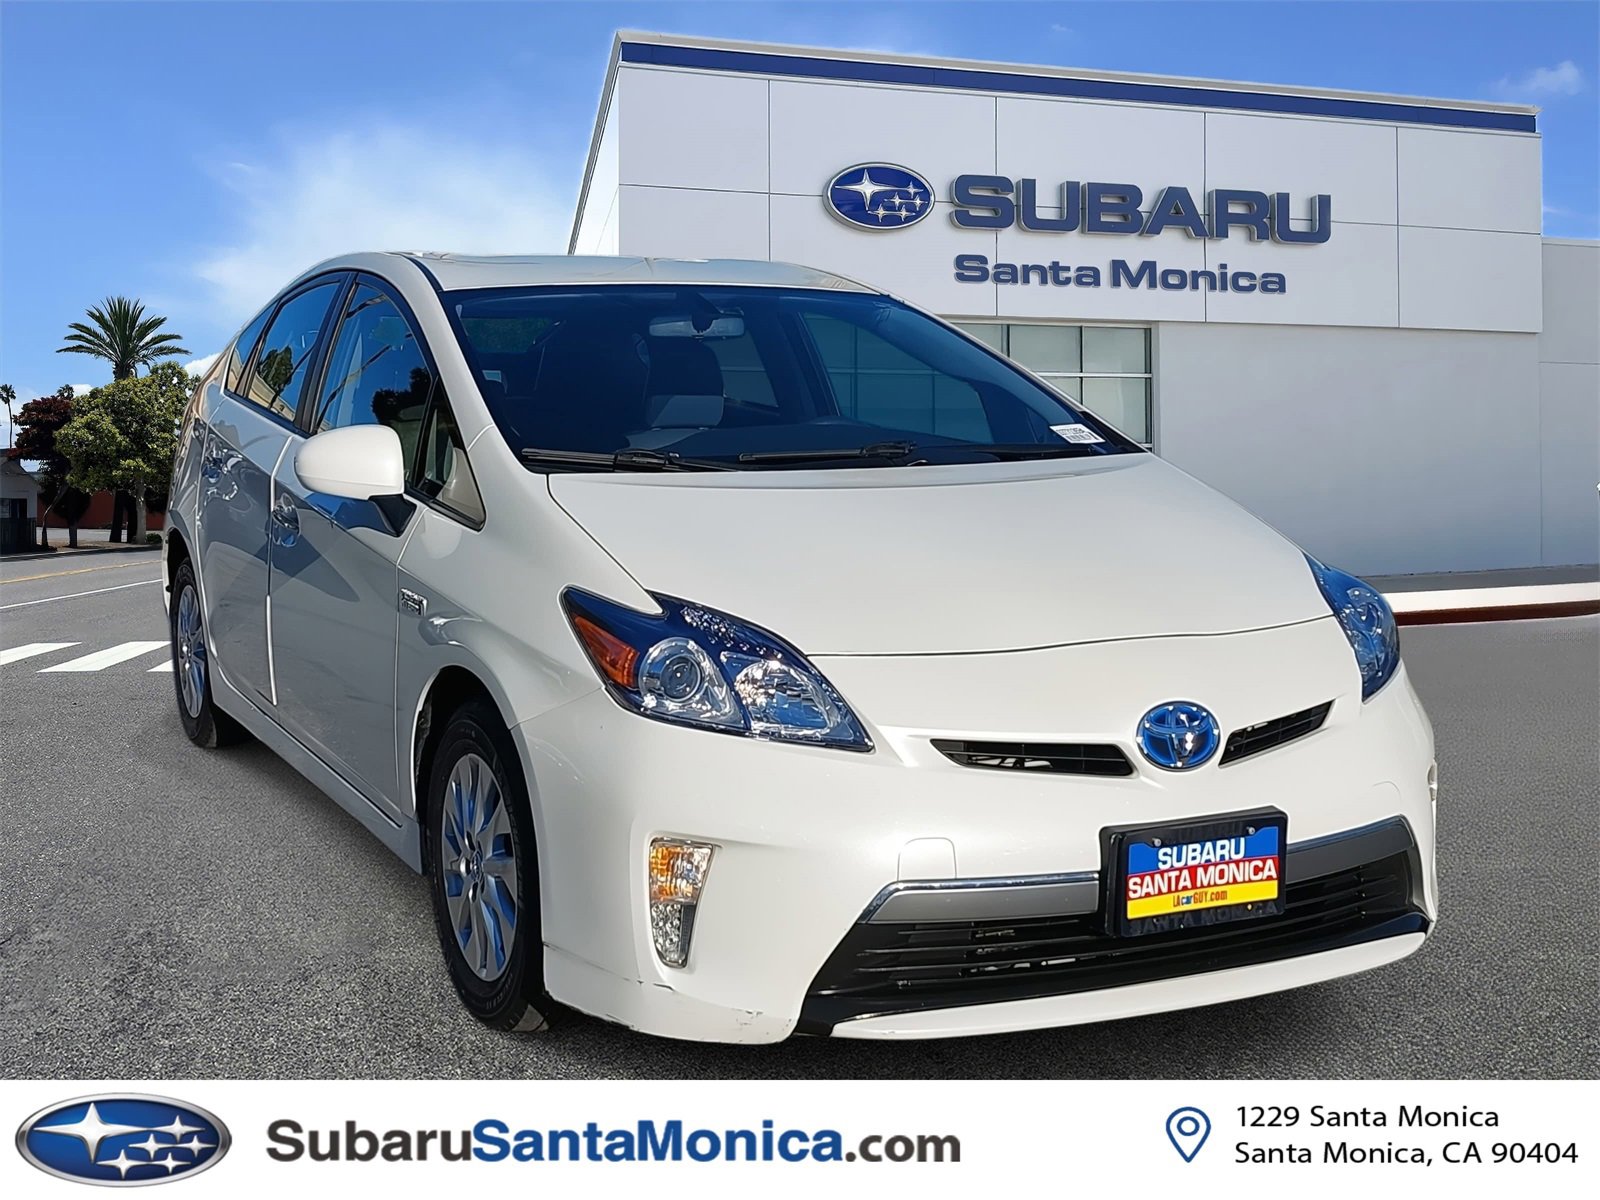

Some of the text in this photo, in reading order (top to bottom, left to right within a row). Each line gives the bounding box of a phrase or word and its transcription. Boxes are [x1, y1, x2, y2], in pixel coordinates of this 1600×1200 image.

[950, 174, 1332, 244] SUBARU
[954, 254, 1287, 294] Santa Monica
[1157, 837, 1246, 870] SUBARU
[1127, 859, 1278, 899] SANTA MONICA
